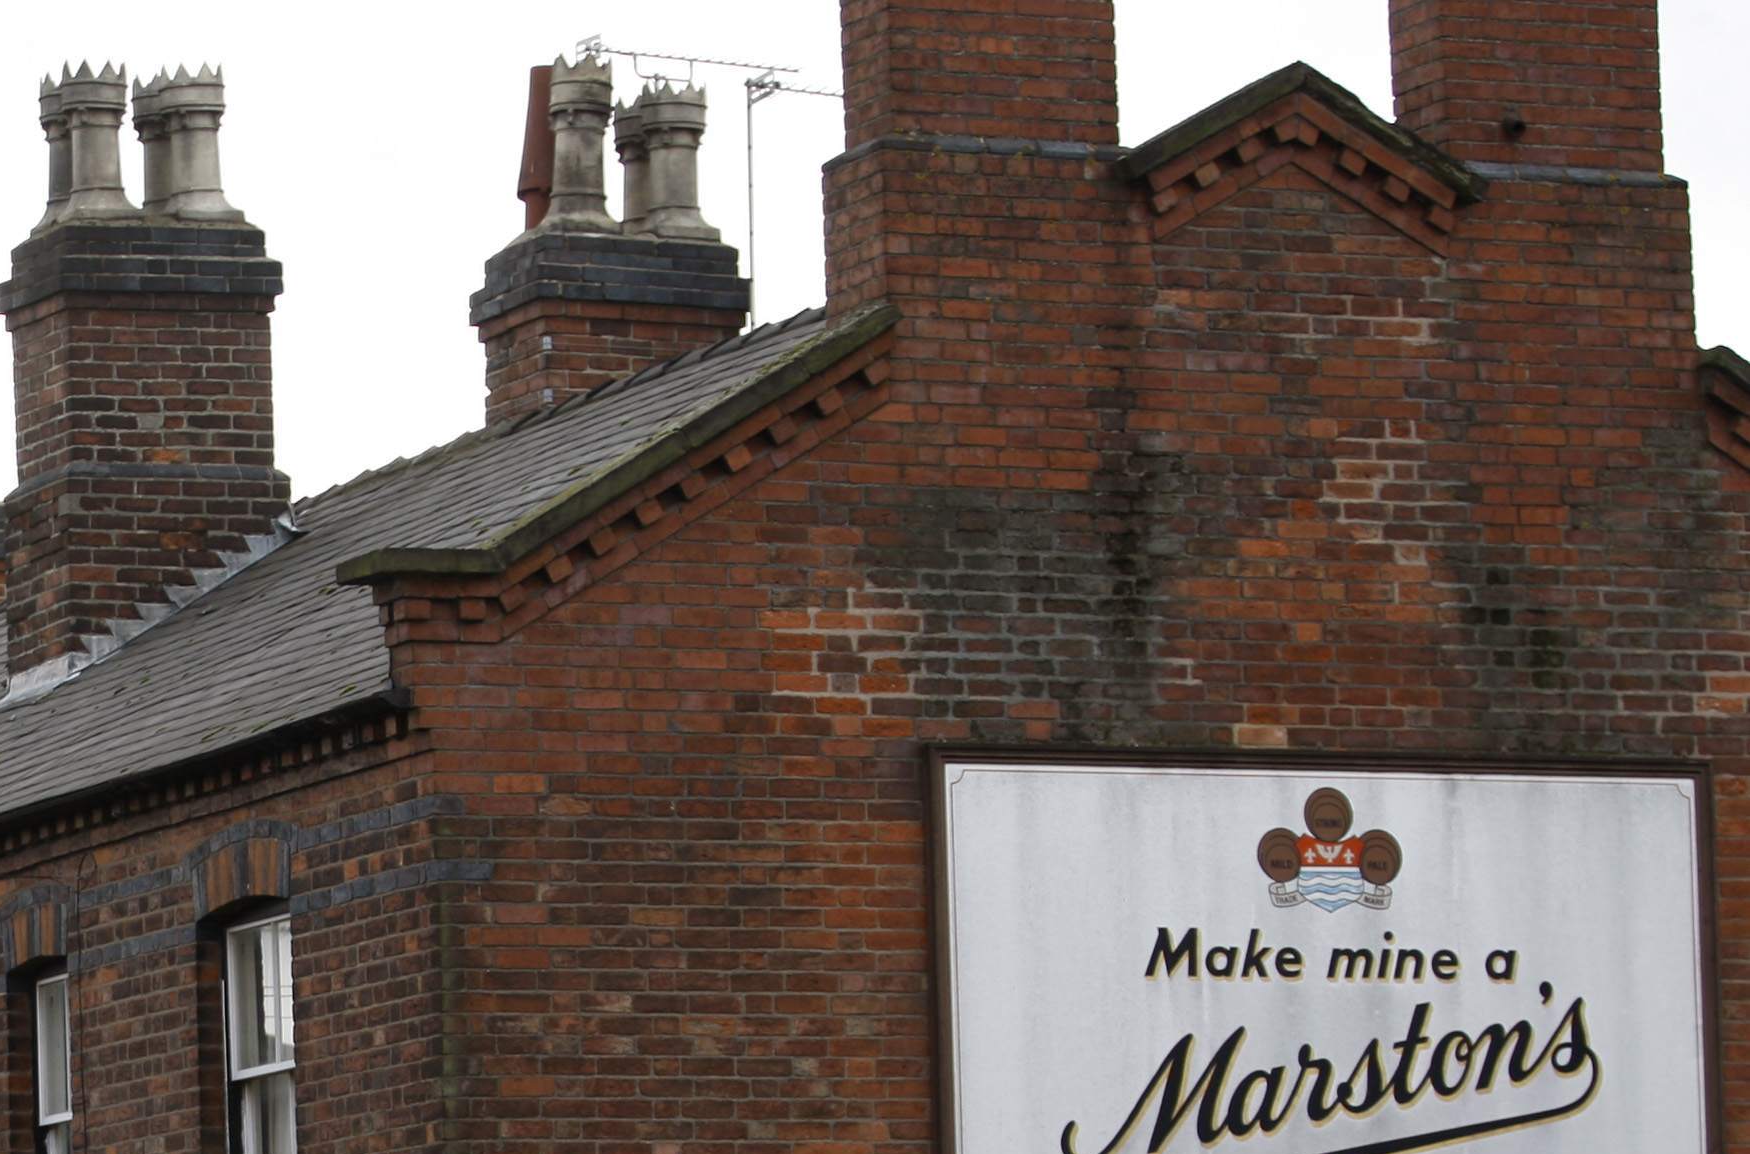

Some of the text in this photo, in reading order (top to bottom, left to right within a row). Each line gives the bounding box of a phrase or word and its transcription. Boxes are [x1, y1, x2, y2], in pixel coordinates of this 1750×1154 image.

[1145, 927, 1519, 981] Make mine a
